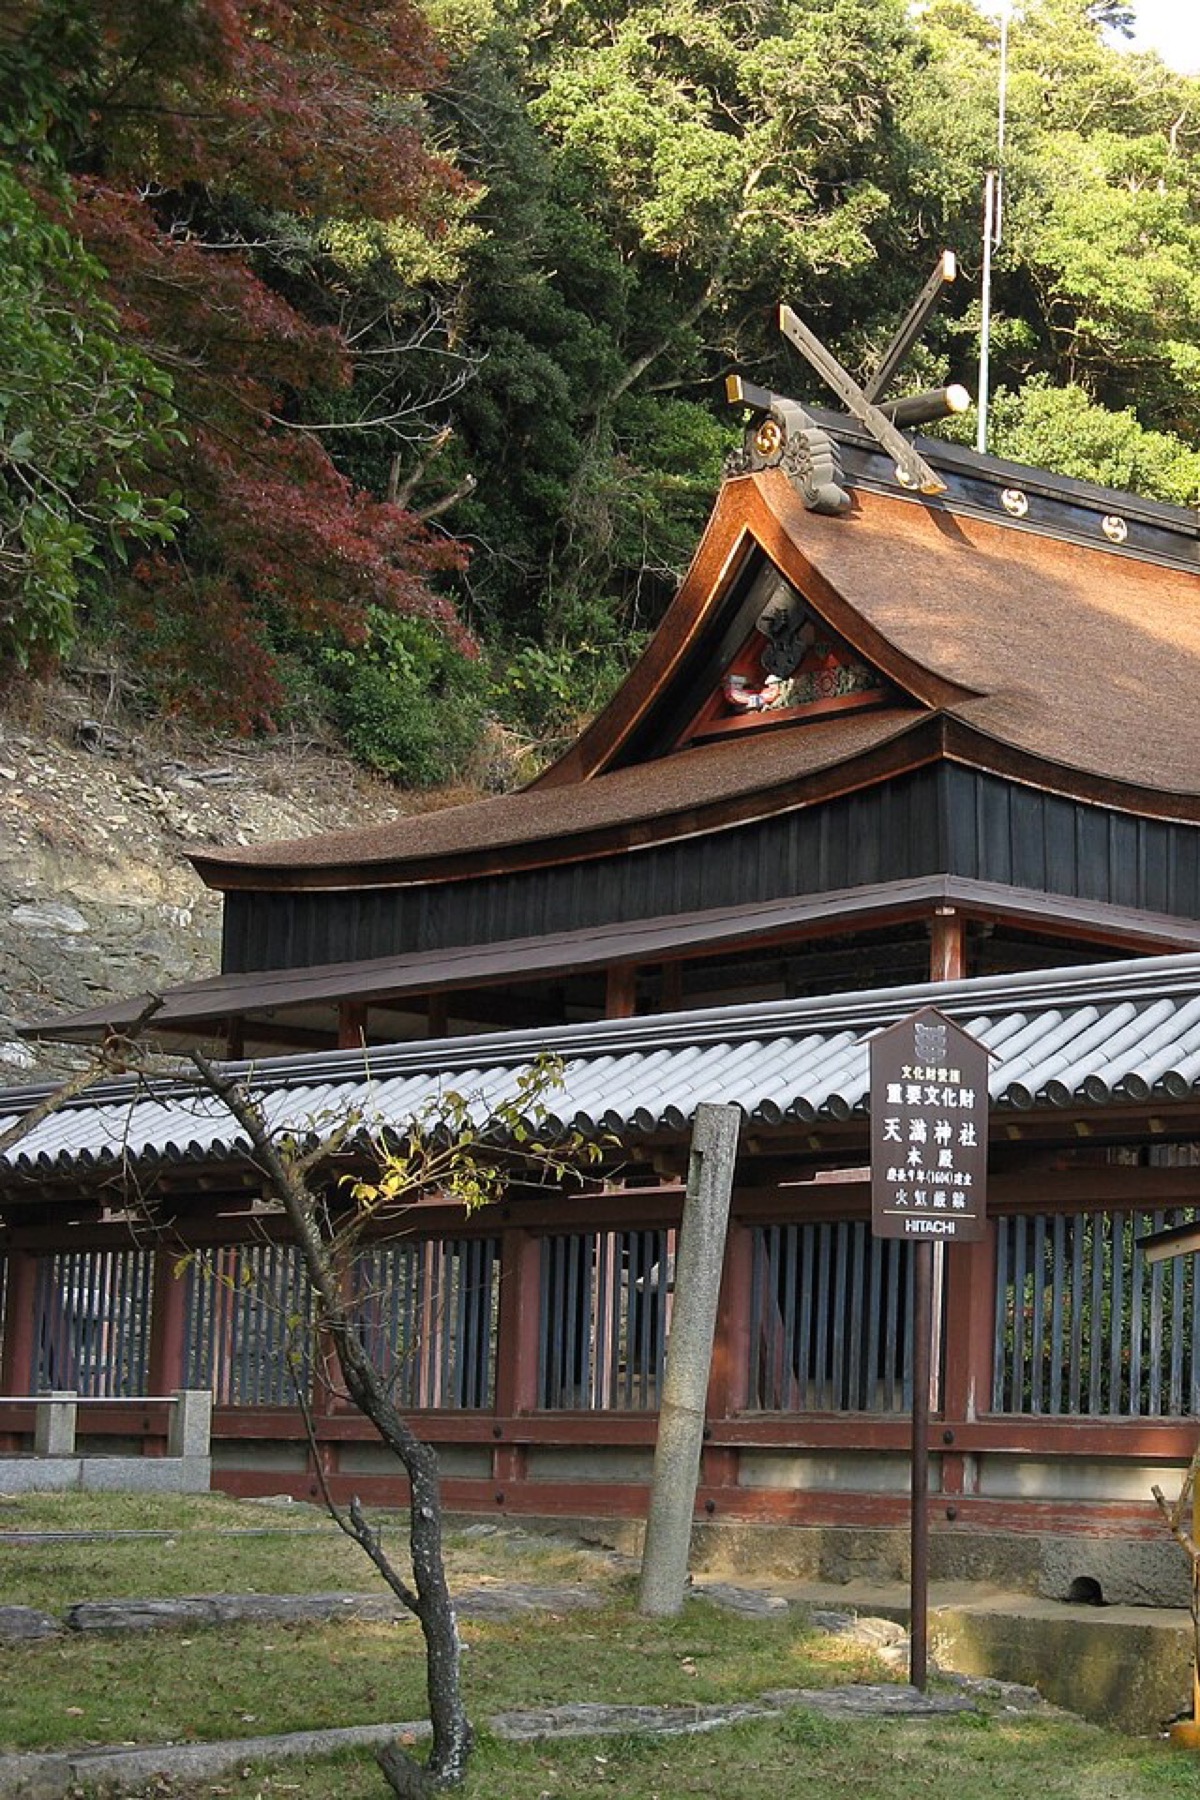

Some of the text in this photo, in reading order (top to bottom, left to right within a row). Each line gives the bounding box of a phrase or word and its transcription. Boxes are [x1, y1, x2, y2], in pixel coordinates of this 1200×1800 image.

[886, 1083, 975, 1109] 重要文化財
[883, 1117, 977, 1147] 天満神社
[907, 1145, 954, 1168] 本殿
[905, 1219, 955, 1235] HITACHI
